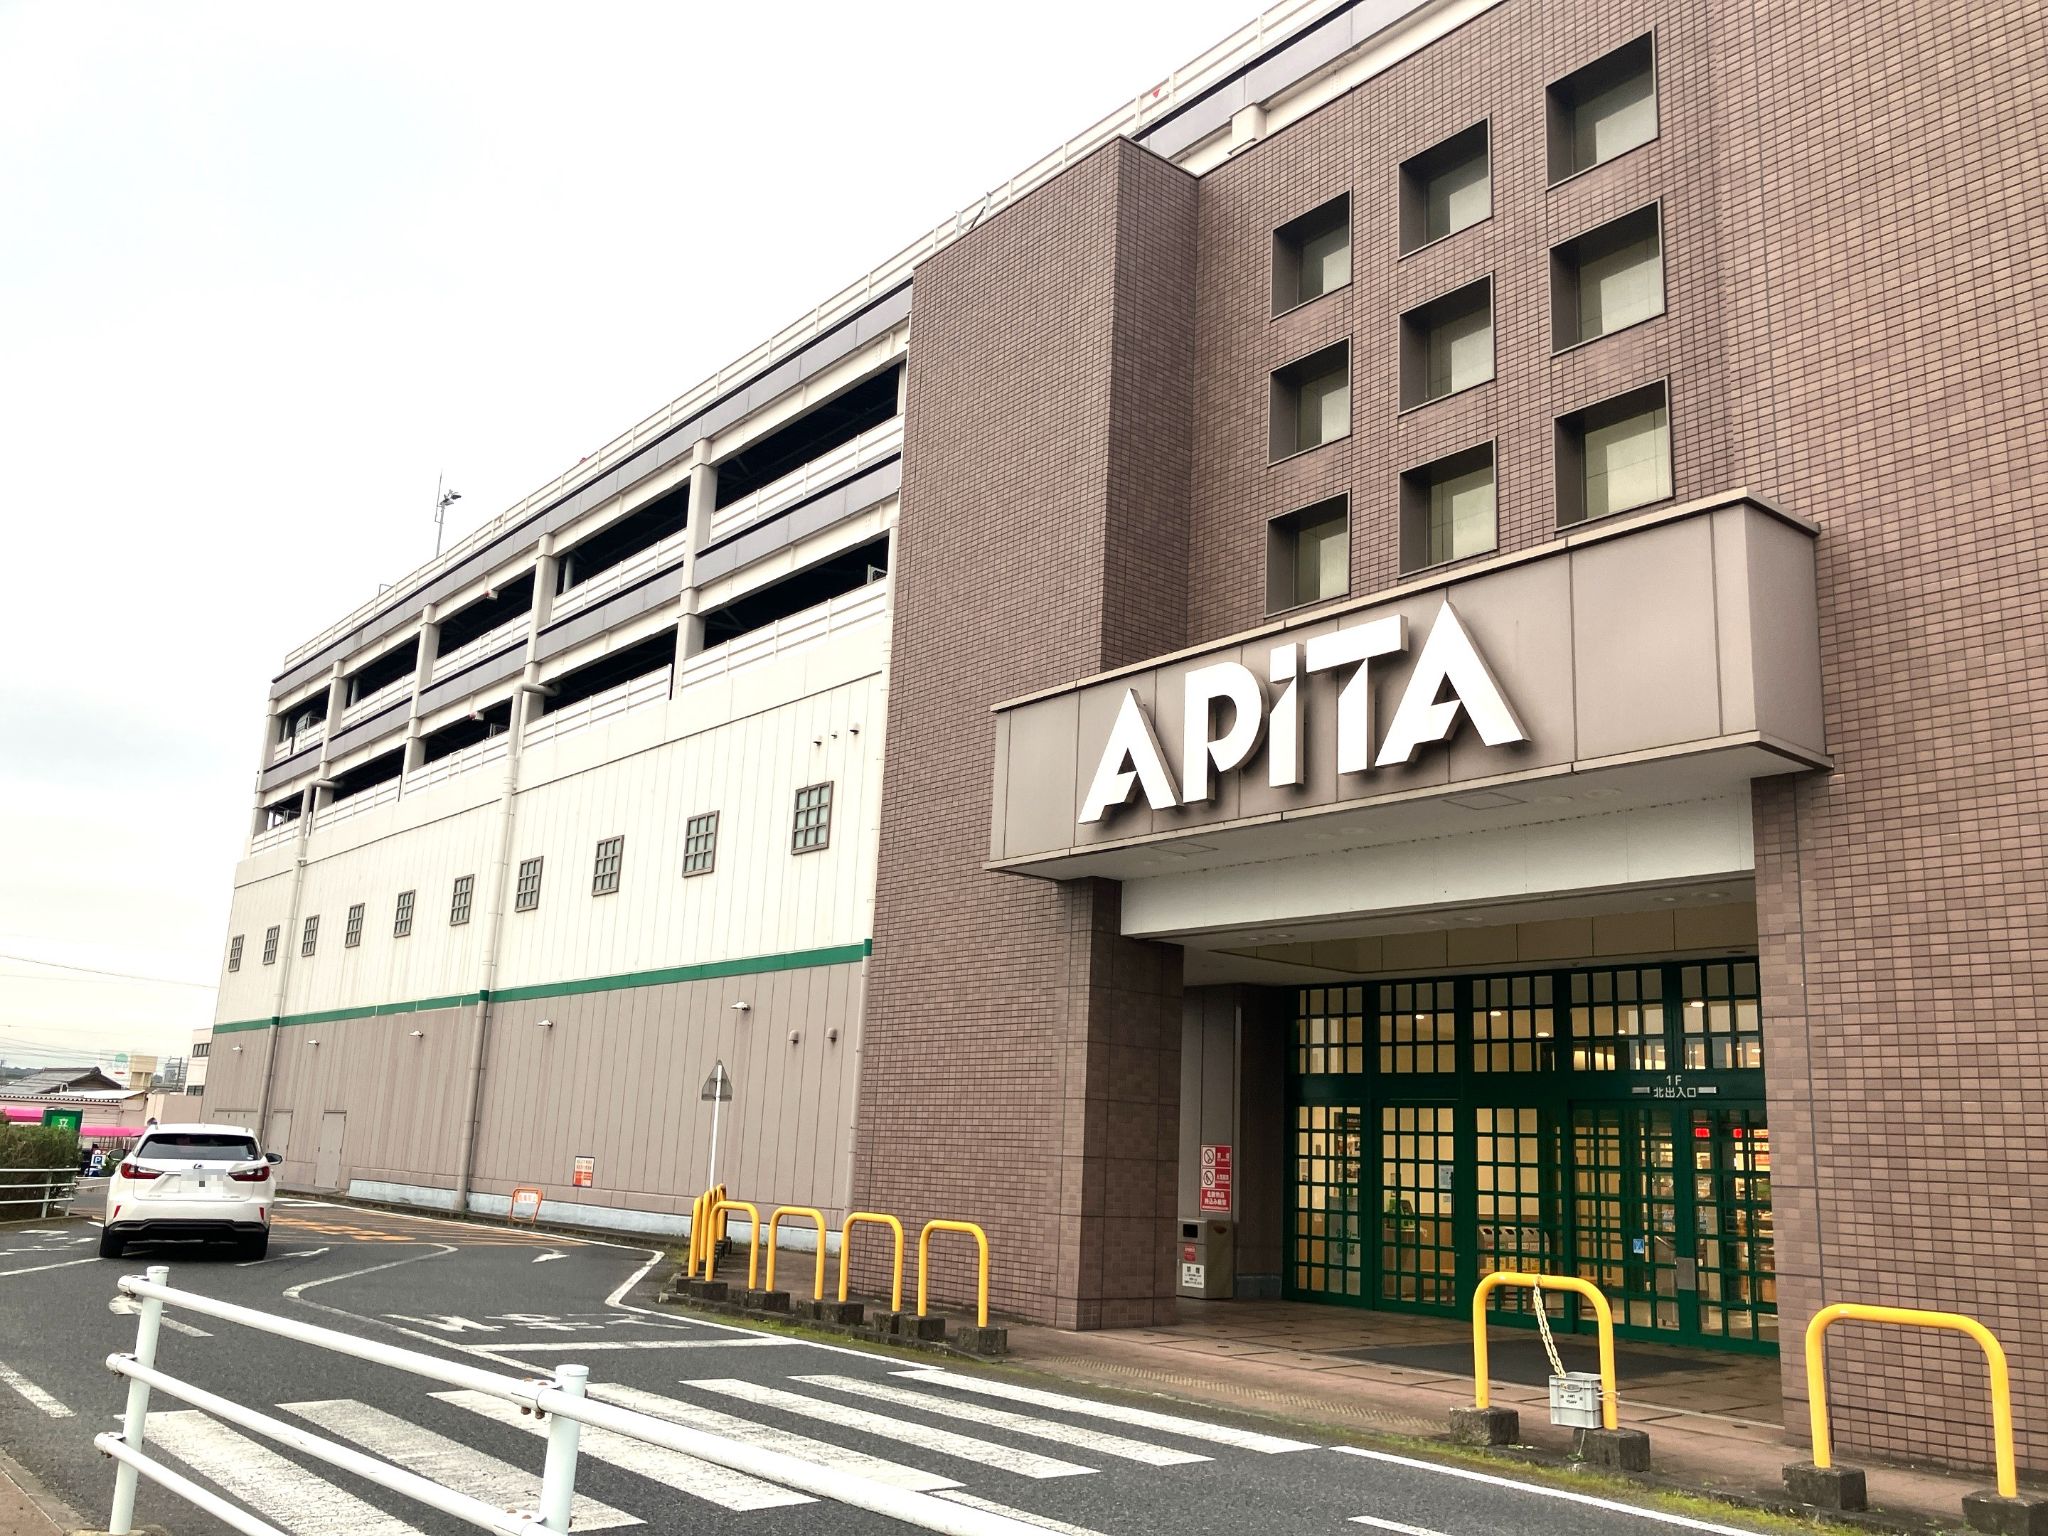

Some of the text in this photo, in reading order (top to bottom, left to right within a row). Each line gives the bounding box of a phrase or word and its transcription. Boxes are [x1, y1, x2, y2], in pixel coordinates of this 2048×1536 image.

[1666, 1075, 1682, 1086] 1F
[1653, 1087, 1697, 1098] 北出入口
